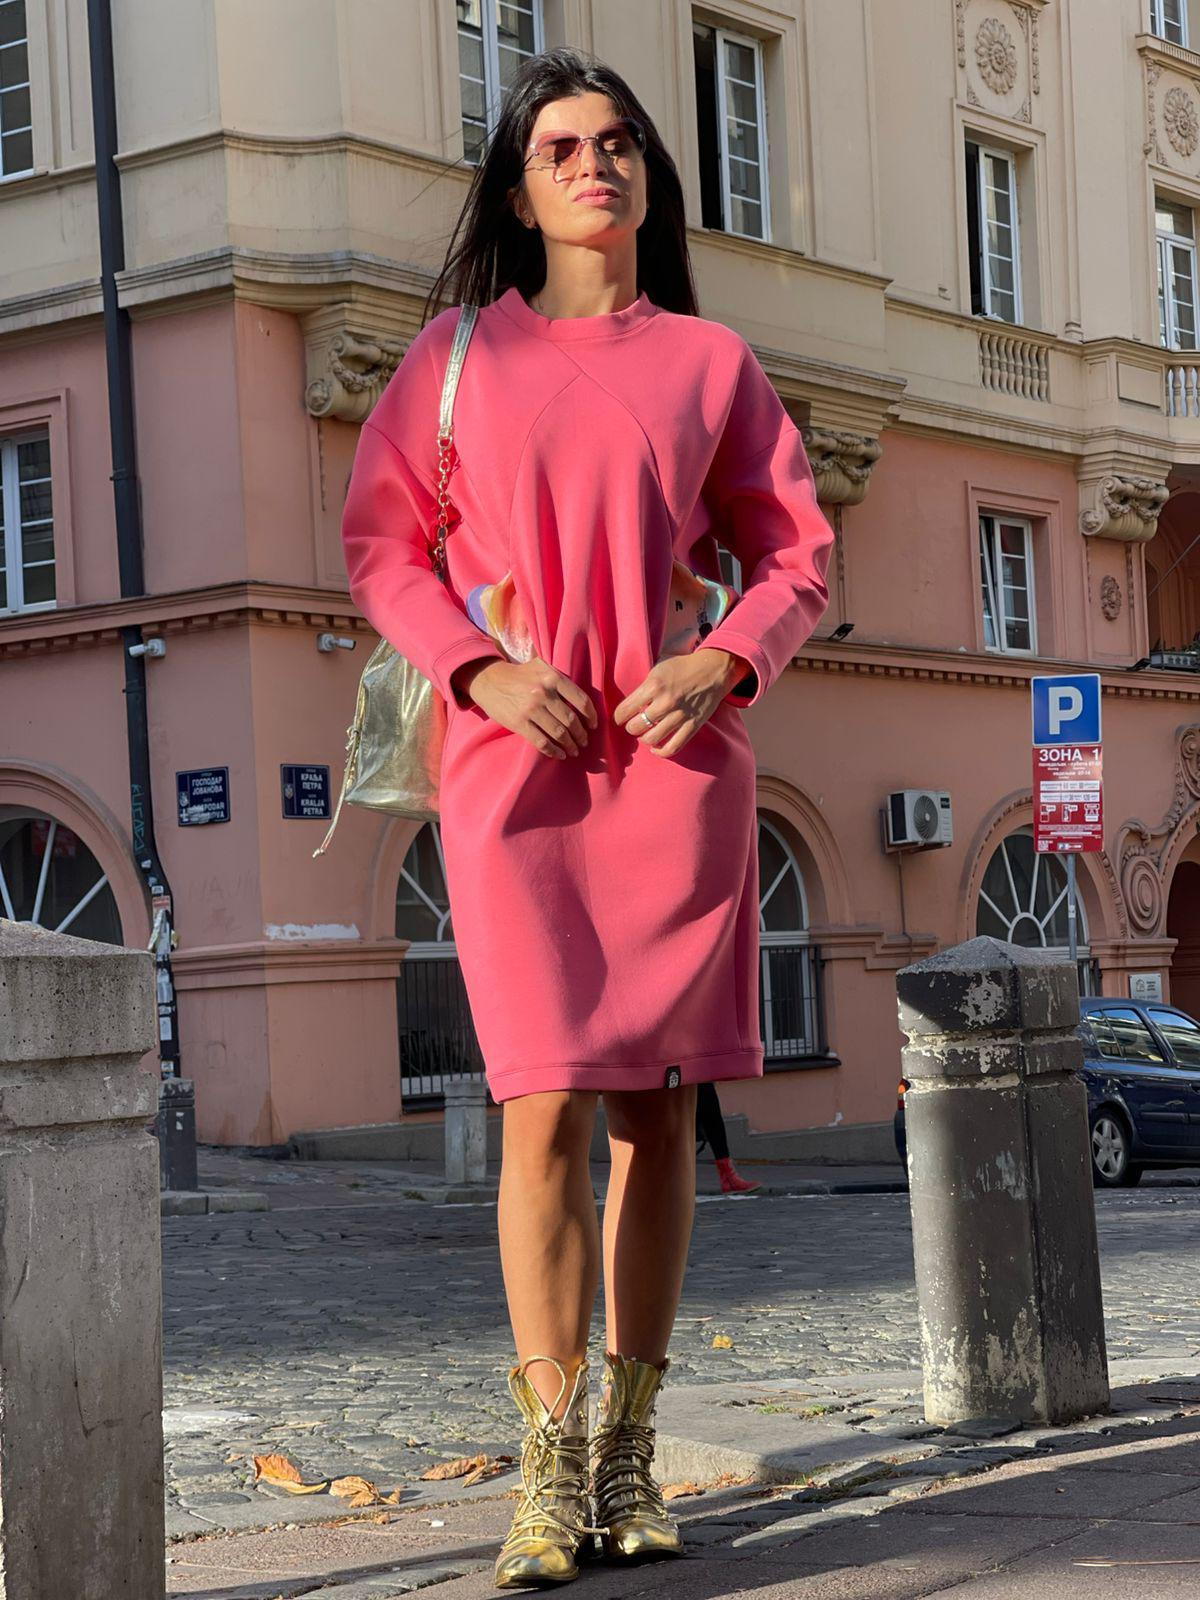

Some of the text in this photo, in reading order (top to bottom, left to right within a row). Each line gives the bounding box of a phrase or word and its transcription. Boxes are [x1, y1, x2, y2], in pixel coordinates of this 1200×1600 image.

[1049, 686, 1083, 735] P
[1039, 748, 1099, 762] ЗОНА 1
[192, 776, 223, 787] ГОСПОДАР
[302, 781, 322, 790] ПЕТРА
[300, 798, 325, 807] KRALJA
[303, 807, 324, 816] PETRA
